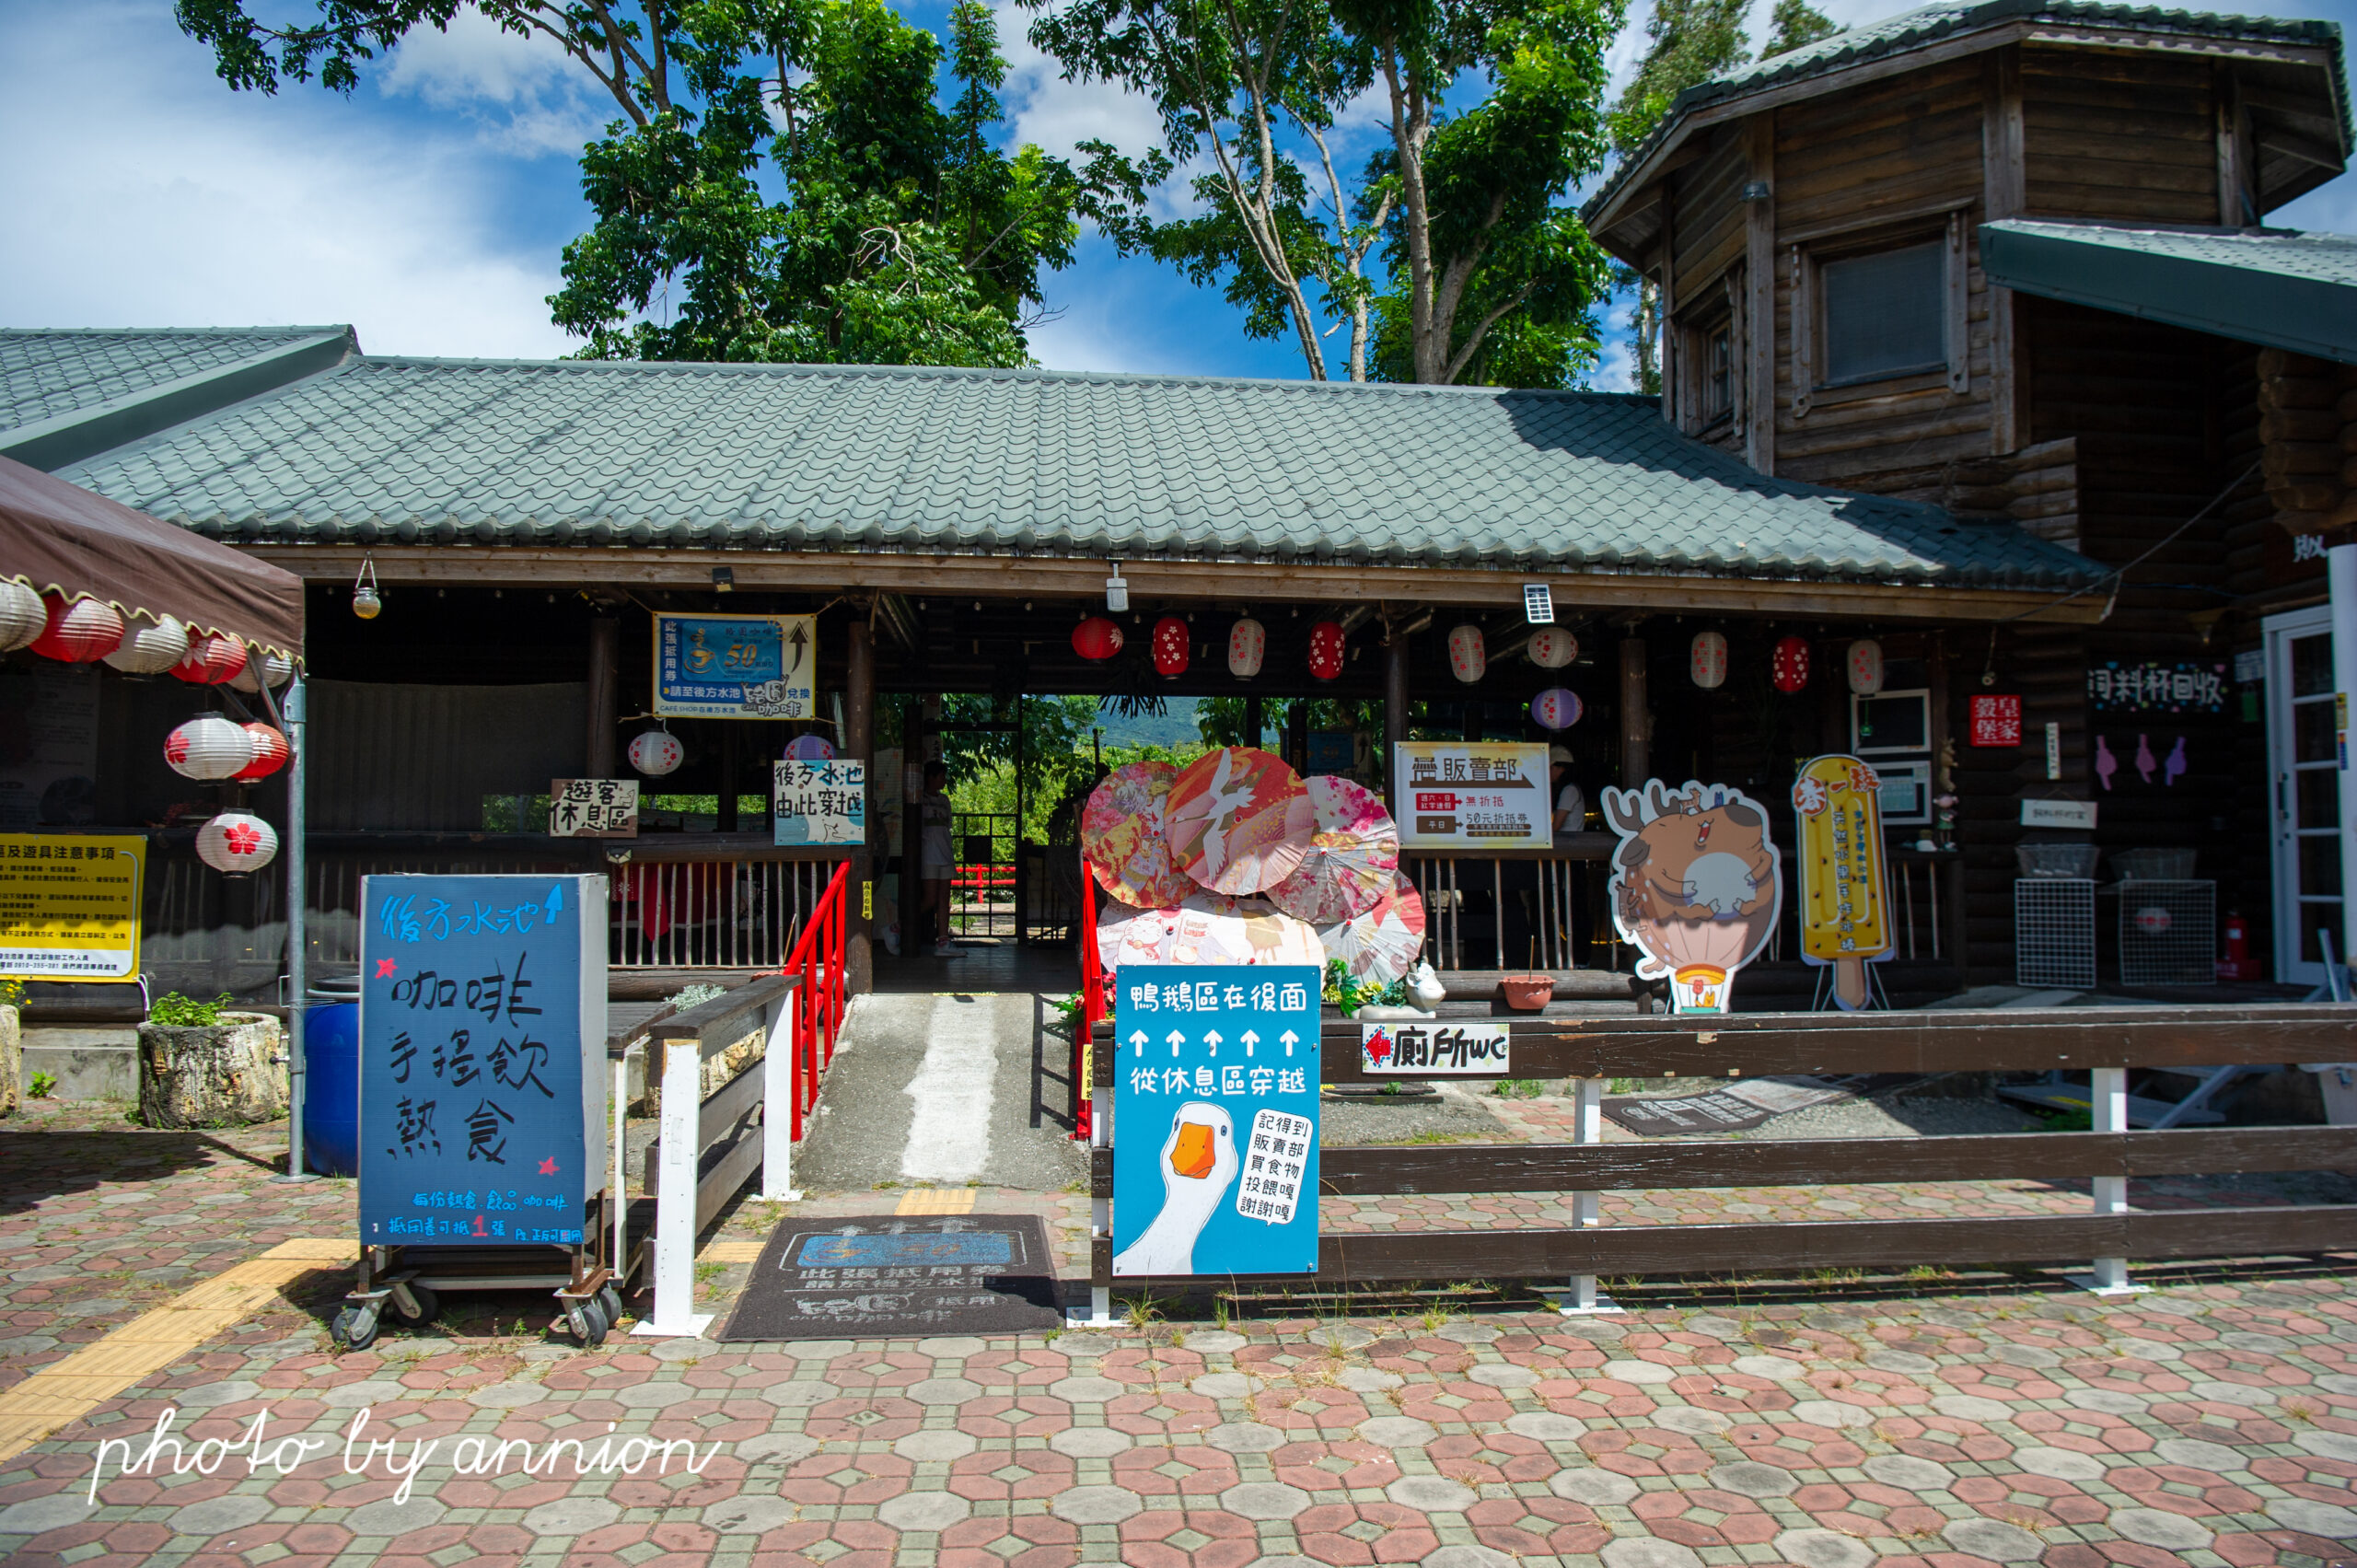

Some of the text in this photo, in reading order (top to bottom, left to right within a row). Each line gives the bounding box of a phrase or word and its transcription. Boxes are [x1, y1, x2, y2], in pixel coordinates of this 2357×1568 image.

[665, 621, 677, 681] 此張抵用券
[724, 644, 757, 668] 50
[670, 686, 740, 699] 請至後方水池
[787, 689, 810, 699] 兌換
[758, 702, 801, 717] 咖啡
[775, 761, 865, 785] 後方水池
[1444, 757, 1518, 781] 販賣部
[563, 779, 619, 805] 遊客
[776, 788, 863, 818] 由此穿越
[1466, 796, 1504, 807] 無折抵
[549, 802, 631, 831] 休息區
[1428, 820, 1446, 829] 平日
[380, 895, 539, 943] 後方水池
[391, 951, 542, 1028] 咖啡
[1131, 981, 1306, 1012] 鴨鵝區在後面
[391, 1028, 555, 1098] 手搖飲
[1130, 1065, 1306, 1096] 從休息區穿越
[388, 1096, 515, 1165] 熱食
[1259, 1113, 1308, 1137] 記得到
[1253, 1133, 1305, 1158] 販賣部
[1250, 1155, 1299, 1179] 買食物
[1245, 1176, 1295, 1200] 投餵嘎
[1240, 1196, 1291, 1221] 謝謝嘎
[797, 1265, 1006, 1280] 此張抵用券
[934, 1295, 996, 1307] 抵用
[833, 1309, 953, 1324] 咖啡
